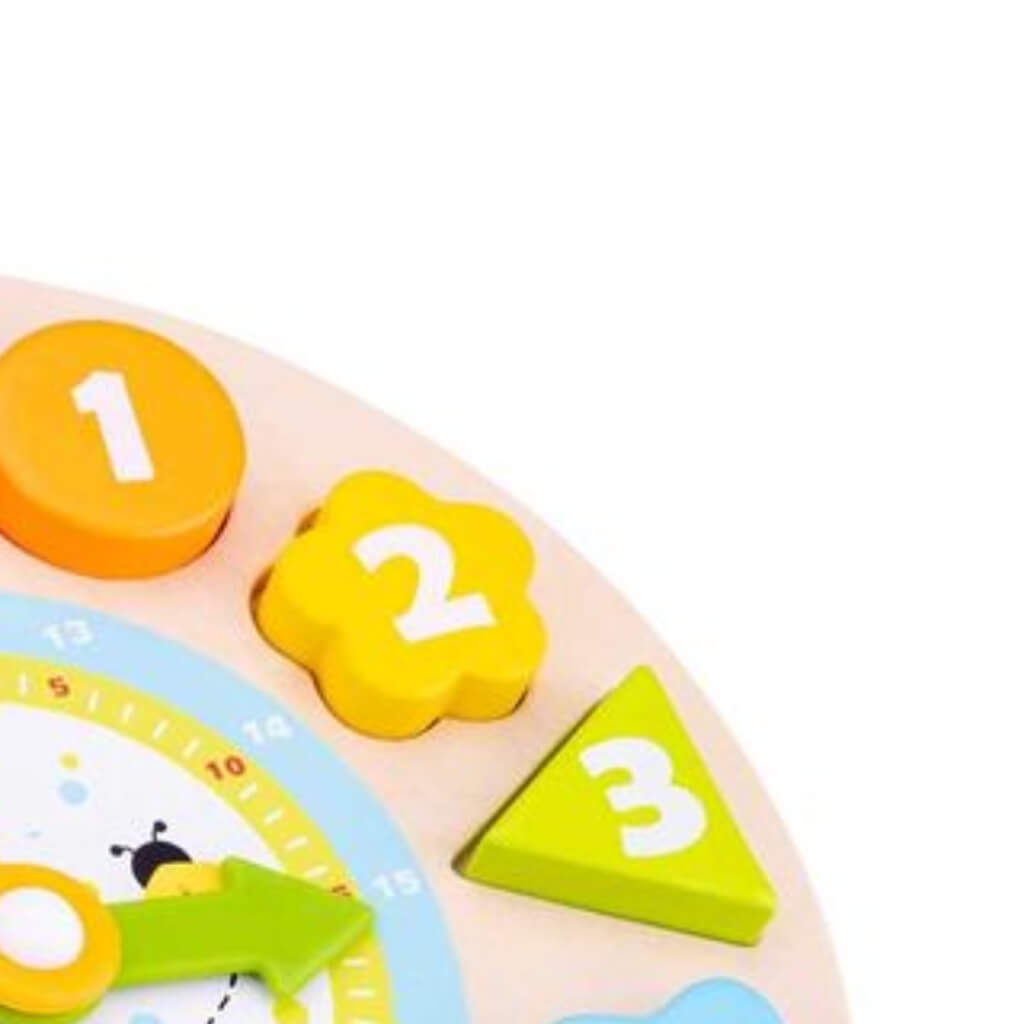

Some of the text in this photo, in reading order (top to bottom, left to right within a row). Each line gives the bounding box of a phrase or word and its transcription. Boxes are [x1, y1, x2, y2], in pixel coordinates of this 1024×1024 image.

[71, 370, 153, 481] 1
[353, 524, 492, 642] 2
[42, 618, 93, 650] 13
[47, 675, 70, 697] 5
[241, 714, 293, 744] 14
[205, 754, 246, 781] 10
[582, 736, 706, 856] 3
[371, 867, 421, 897] 15
